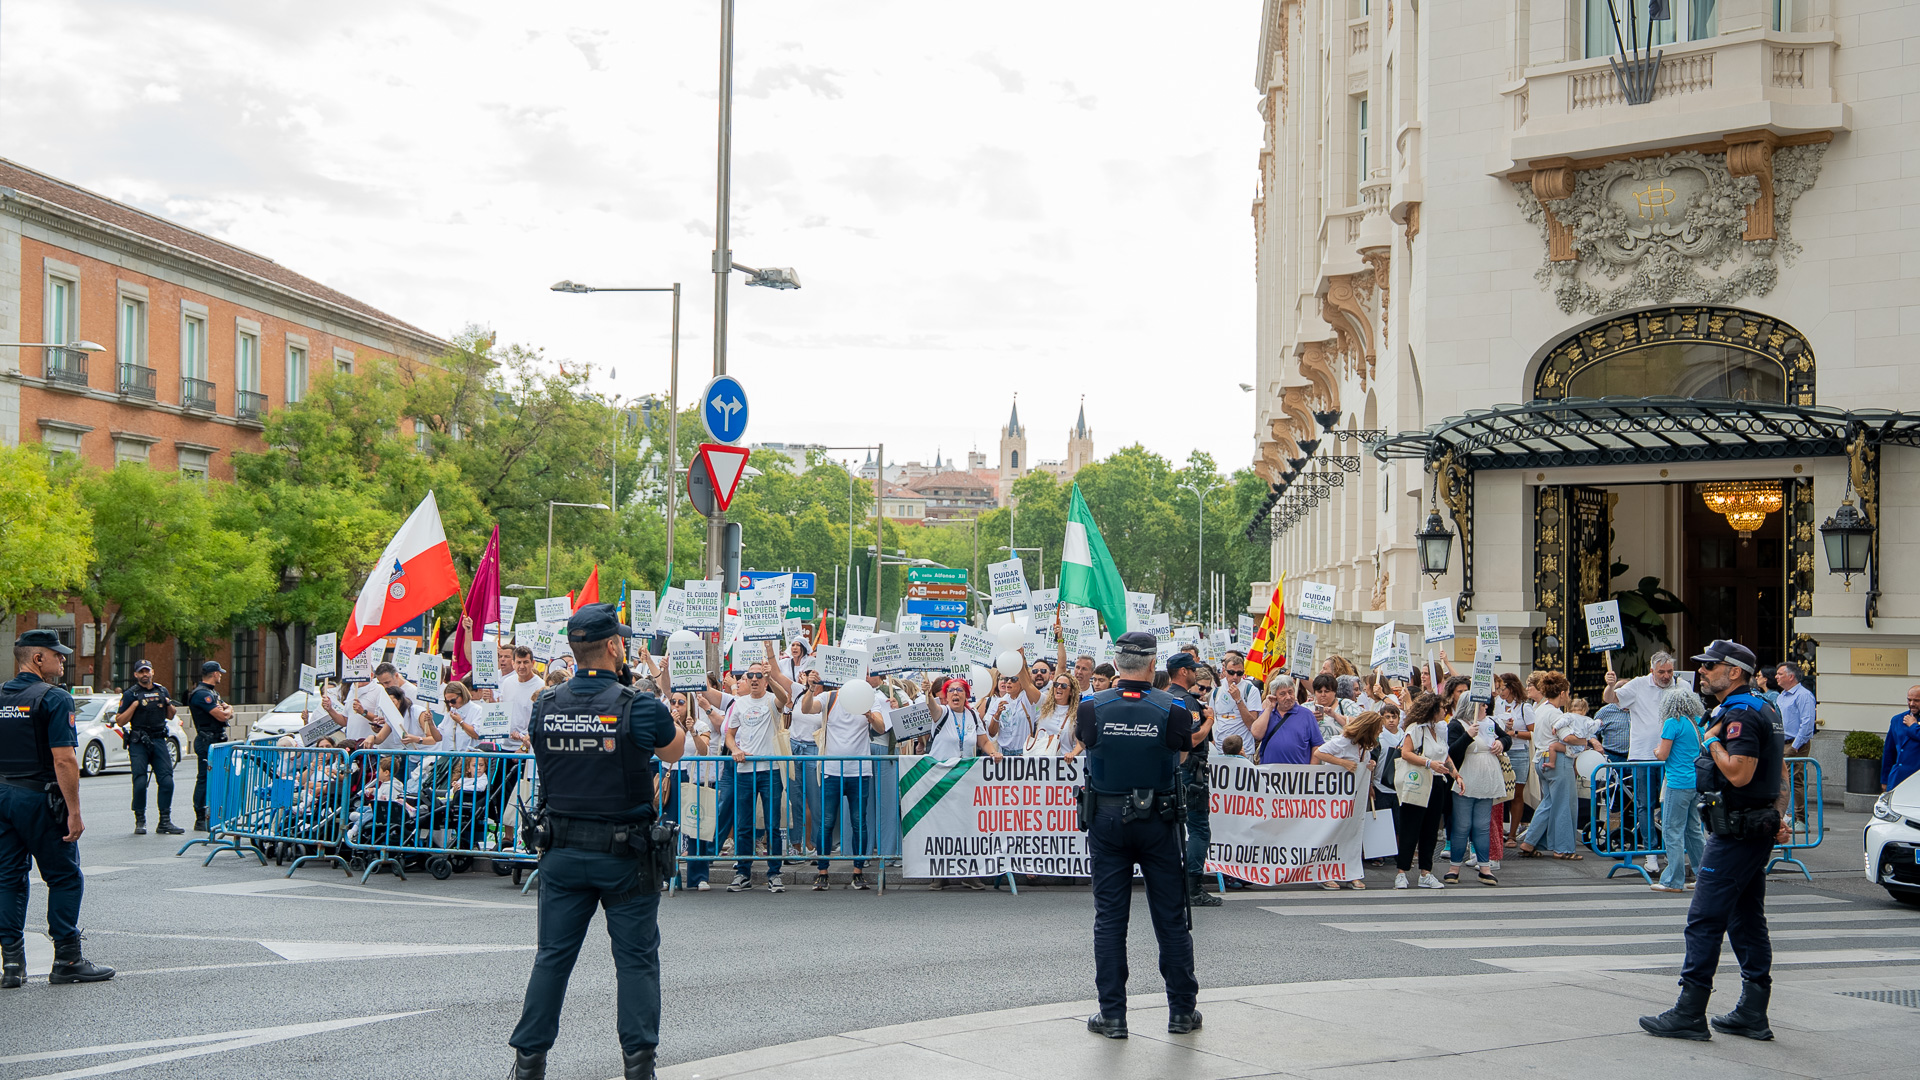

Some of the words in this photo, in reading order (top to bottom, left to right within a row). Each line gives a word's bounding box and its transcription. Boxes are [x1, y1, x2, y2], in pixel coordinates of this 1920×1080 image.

[994, 570, 1019, 579] CUIDAR
[793, 580, 808, 588] A-2
[994, 576, 1020, 586] TAMBIÉN
[994, 583, 1021, 592] MERECE
[995, 589, 1022, 598] PROTECCIÓN
[1305, 593, 1331, 602] CUIDAR
[755, 606, 777, 614] PUEDE
[1034, 604, 1042, 612] NO
[1302, 602, 1332, 612] DERECHO
[1590, 615, 1615, 626] CUIDAR
[1481, 631, 1498, 640] MENOS
[1591, 627, 1619, 637] DERECHO
[537, 635, 552, 644] NO
[979, 637, 994, 647] PASO
[1378, 636, 1388, 645] NO
[319, 647, 333, 655] HIJOS
[960, 641, 991, 655] DERECHOS
[422, 663, 438, 672] CUIDAR
[675, 660, 688, 669] NO
[690, 660, 702, 669] LA
[422, 670, 437, 680] NO
[672, 668, 705, 676] BUROCRACIA
[1475, 674, 1491, 682] MERECE
[543, 714, 601, 723] POLICIA
[543, 723, 616, 732] NACIONAL
[1103, 722, 1159, 733] POLICÍA
[546, 738, 603, 751] U.I.P.
[982, 757, 1049, 781] CUIDAR
[1056, 757, 1077, 781] ES
[1209, 764, 1230, 789] NO
[1235, 766, 1260, 793] UN
[973, 785, 1019, 806] ANTES
[1023, 785, 1041, 806] DE
[1224, 794, 1267, 820] VIDAS,
[1271, 799, 1327, 819] SENTAOS
[1330, 798, 1355, 819] CON
[978, 809, 1043, 833] QUIENES
[924, 832, 1003, 856] ANDALUCÍA
[1006, 836, 1081, 855] PRESENTE.
[1236, 845, 1260, 865] QUE
[1262, 846, 1287, 866] NOS
[1290, 844, 1341, 866] SILENCIA.
[929, 858, 980, 876] MESA
[985, 856, 1006, 875] DE
[1275, 864, 1314, 885] CUME
